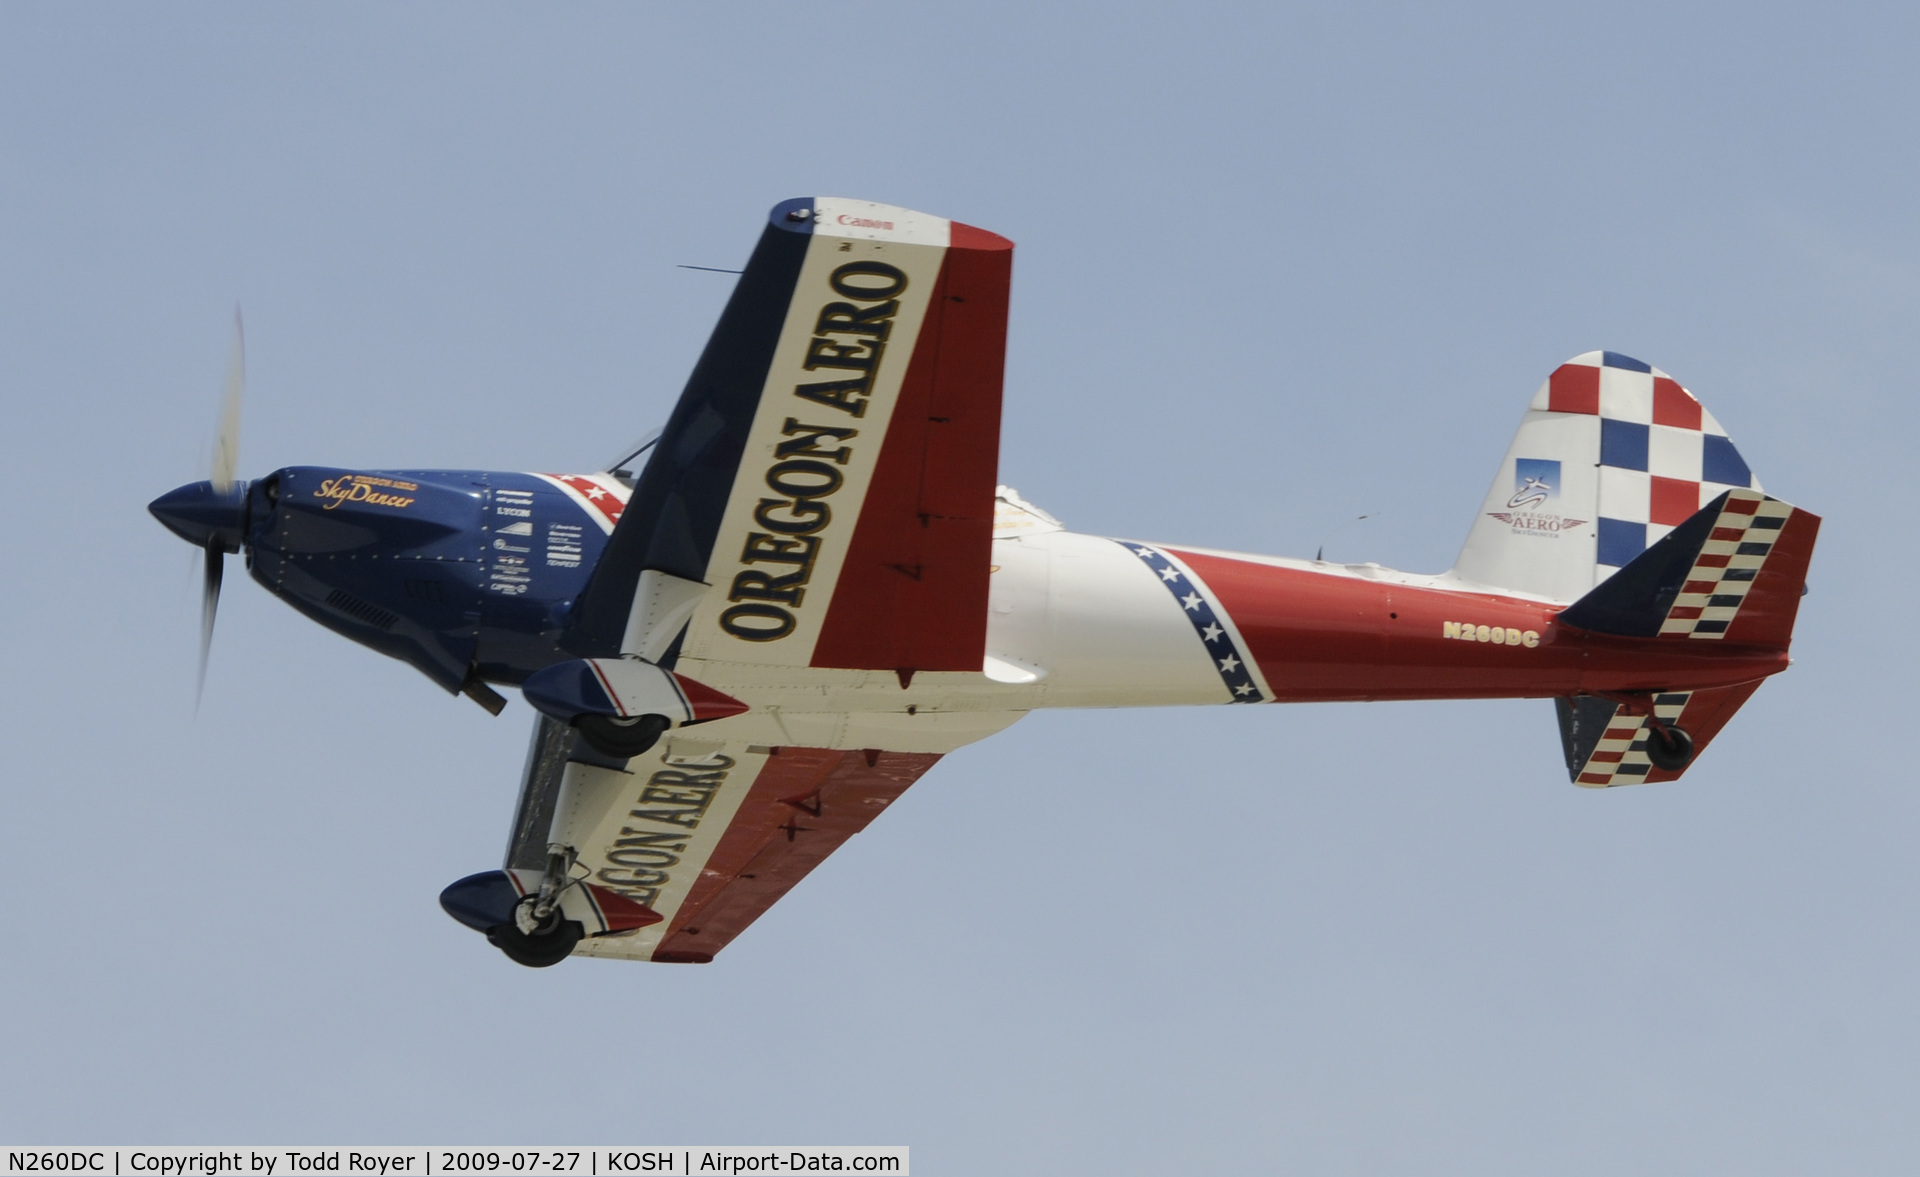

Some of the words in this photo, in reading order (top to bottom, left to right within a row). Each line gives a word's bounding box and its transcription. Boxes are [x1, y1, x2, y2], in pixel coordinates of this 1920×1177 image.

[837, 214, 894, 231] Canon
[719, 417, 858, 642] OREGON
[794, 260, 908, 418] AERO
[313, 475, 415, 510] SkyDancer
[1512, 517, 1560, 532] AERO
[1443, 621, 1540, 648] N260DC
